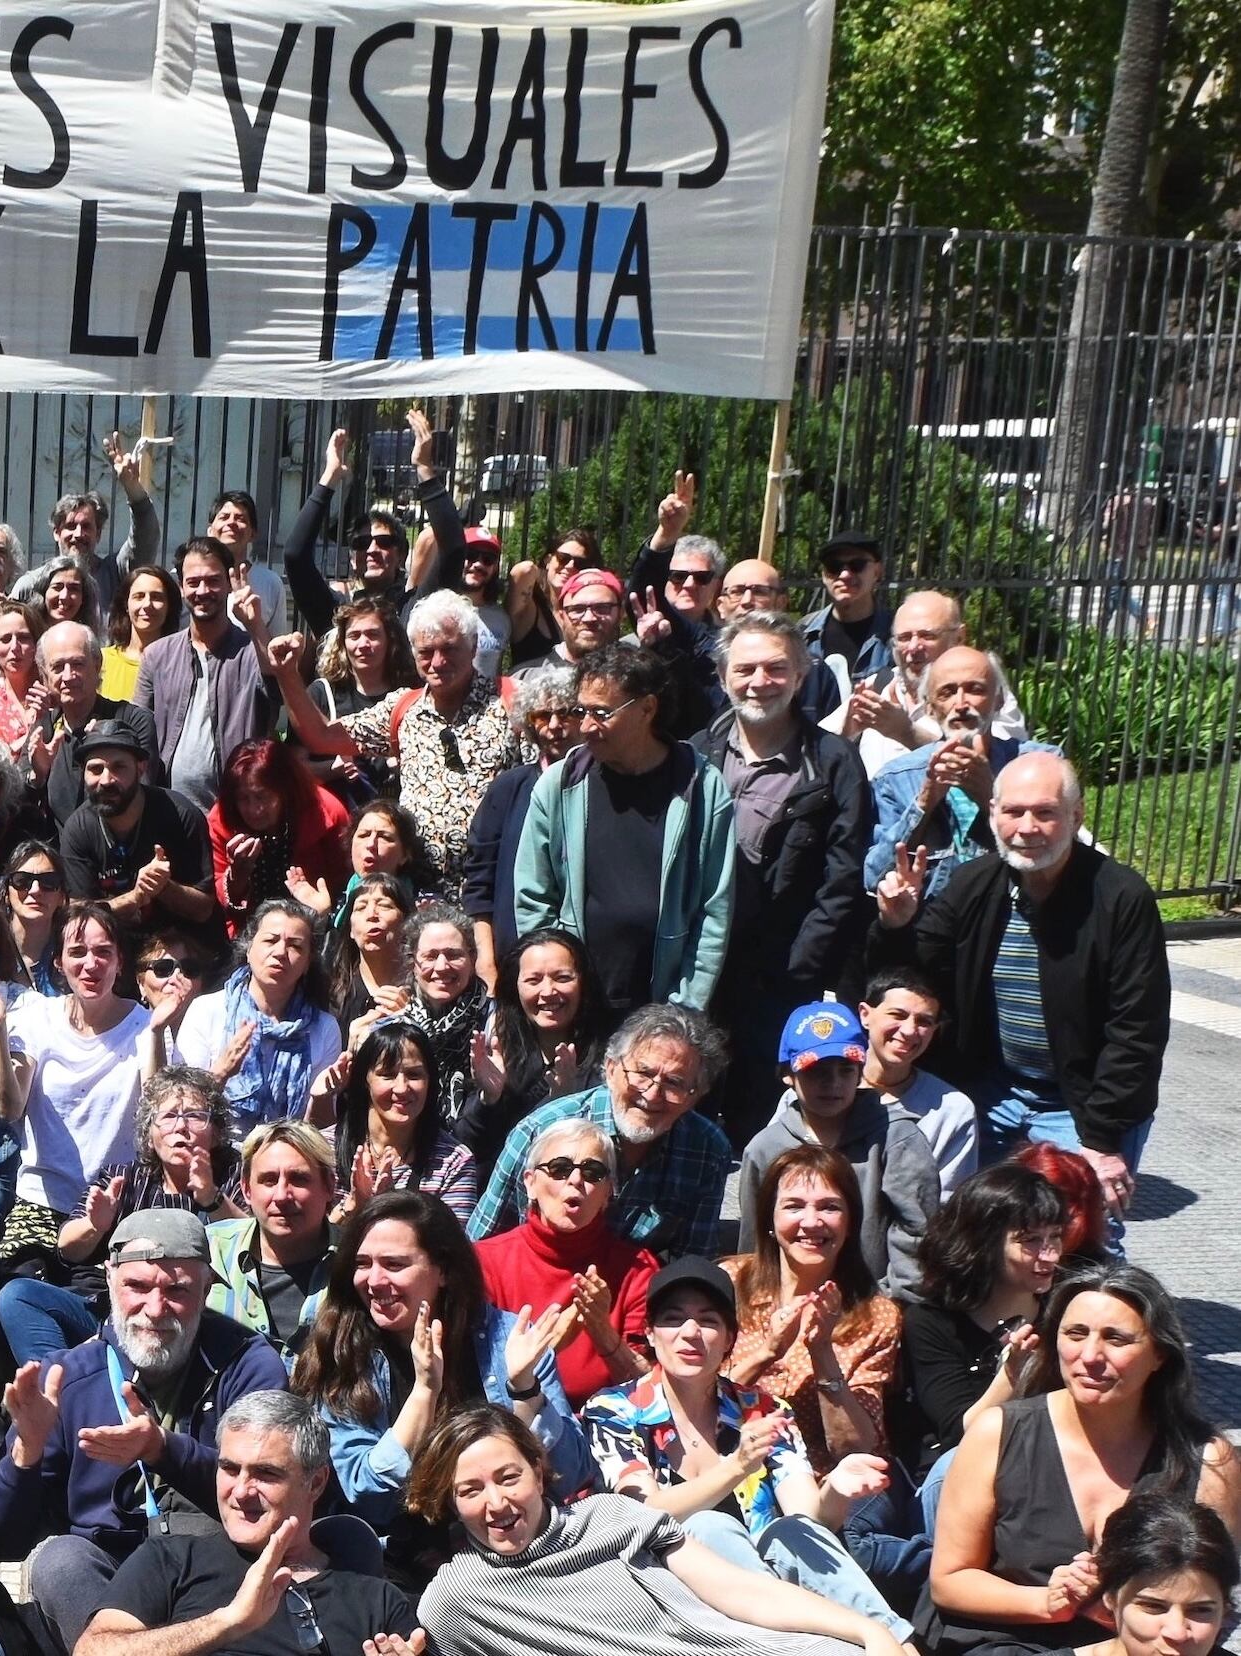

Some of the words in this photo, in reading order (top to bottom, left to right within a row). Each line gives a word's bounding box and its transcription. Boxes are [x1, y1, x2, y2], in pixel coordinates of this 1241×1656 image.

[210, 18, 742, 193] VISUALES
[69, 191, 212, 359] LA
[318, 201, 657, 361] PATRIA
